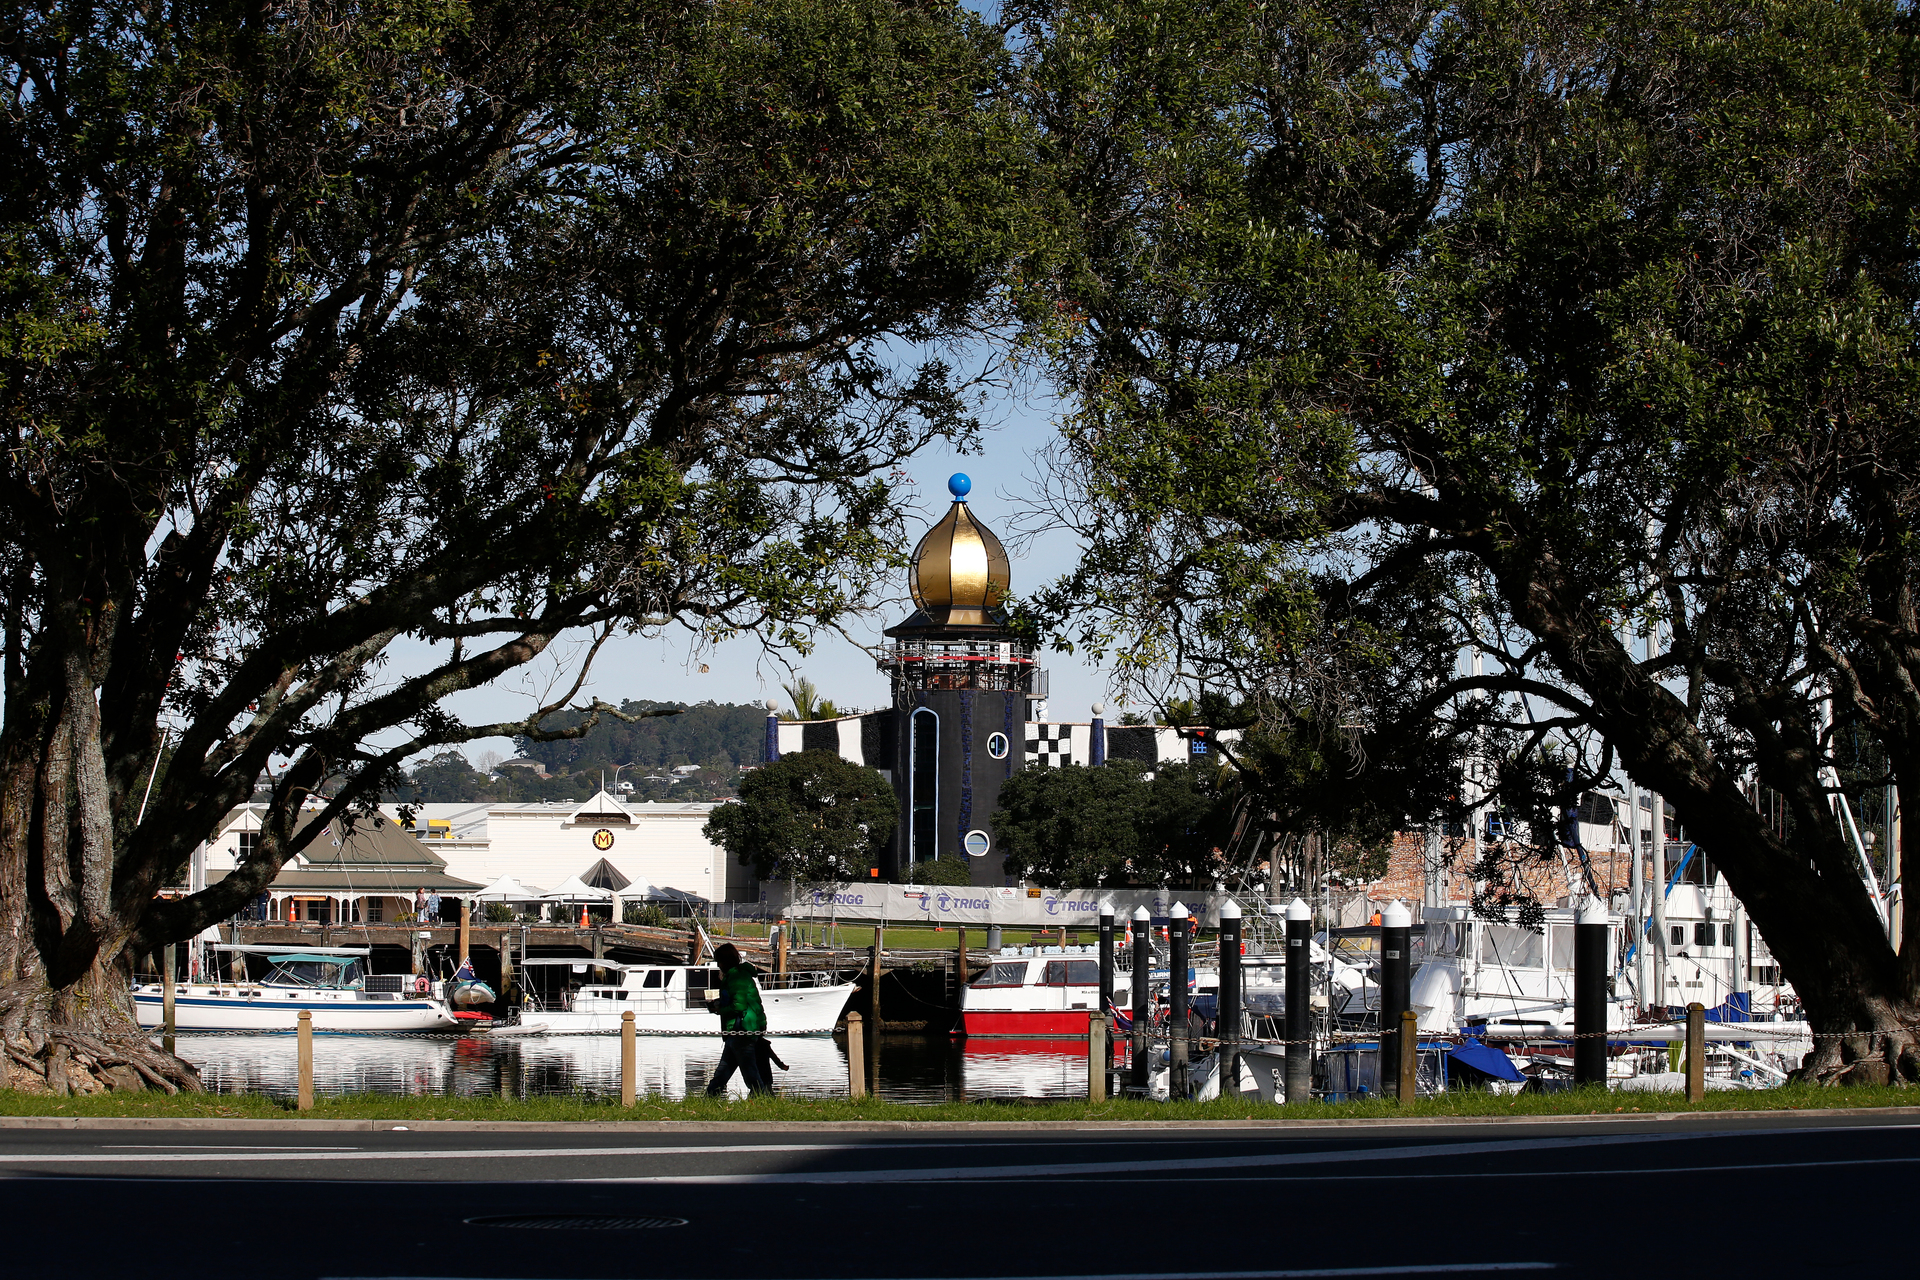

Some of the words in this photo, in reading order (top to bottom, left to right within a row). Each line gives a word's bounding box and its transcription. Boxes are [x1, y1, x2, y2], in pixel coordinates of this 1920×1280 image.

[598, 834, 609, 845] M
[828, 893, 864, 904] TRIGG
[953, 898, 989, 909] TRIGG
[1061, 901, 1098, 912] TRIGG
